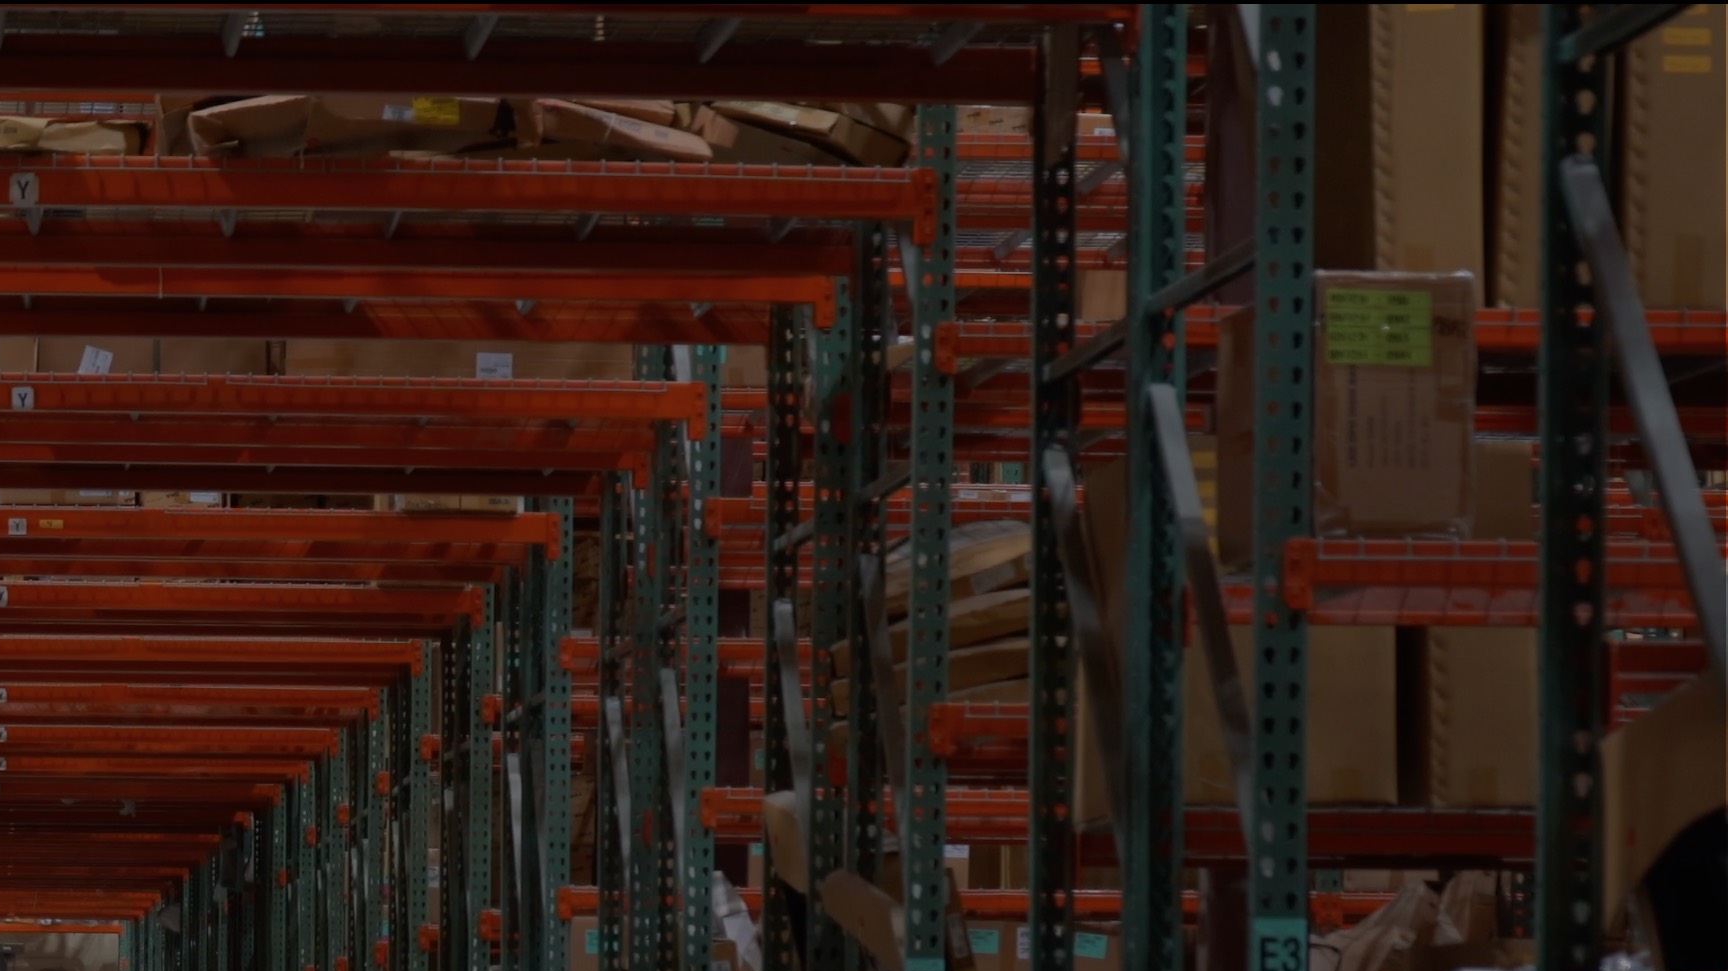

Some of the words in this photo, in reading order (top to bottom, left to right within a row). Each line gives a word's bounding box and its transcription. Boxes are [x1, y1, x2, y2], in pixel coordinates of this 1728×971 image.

[17, 180, 29, 200] Y
[18, 392, 28, 407] Y
[13, 520, 20, 532] Y
